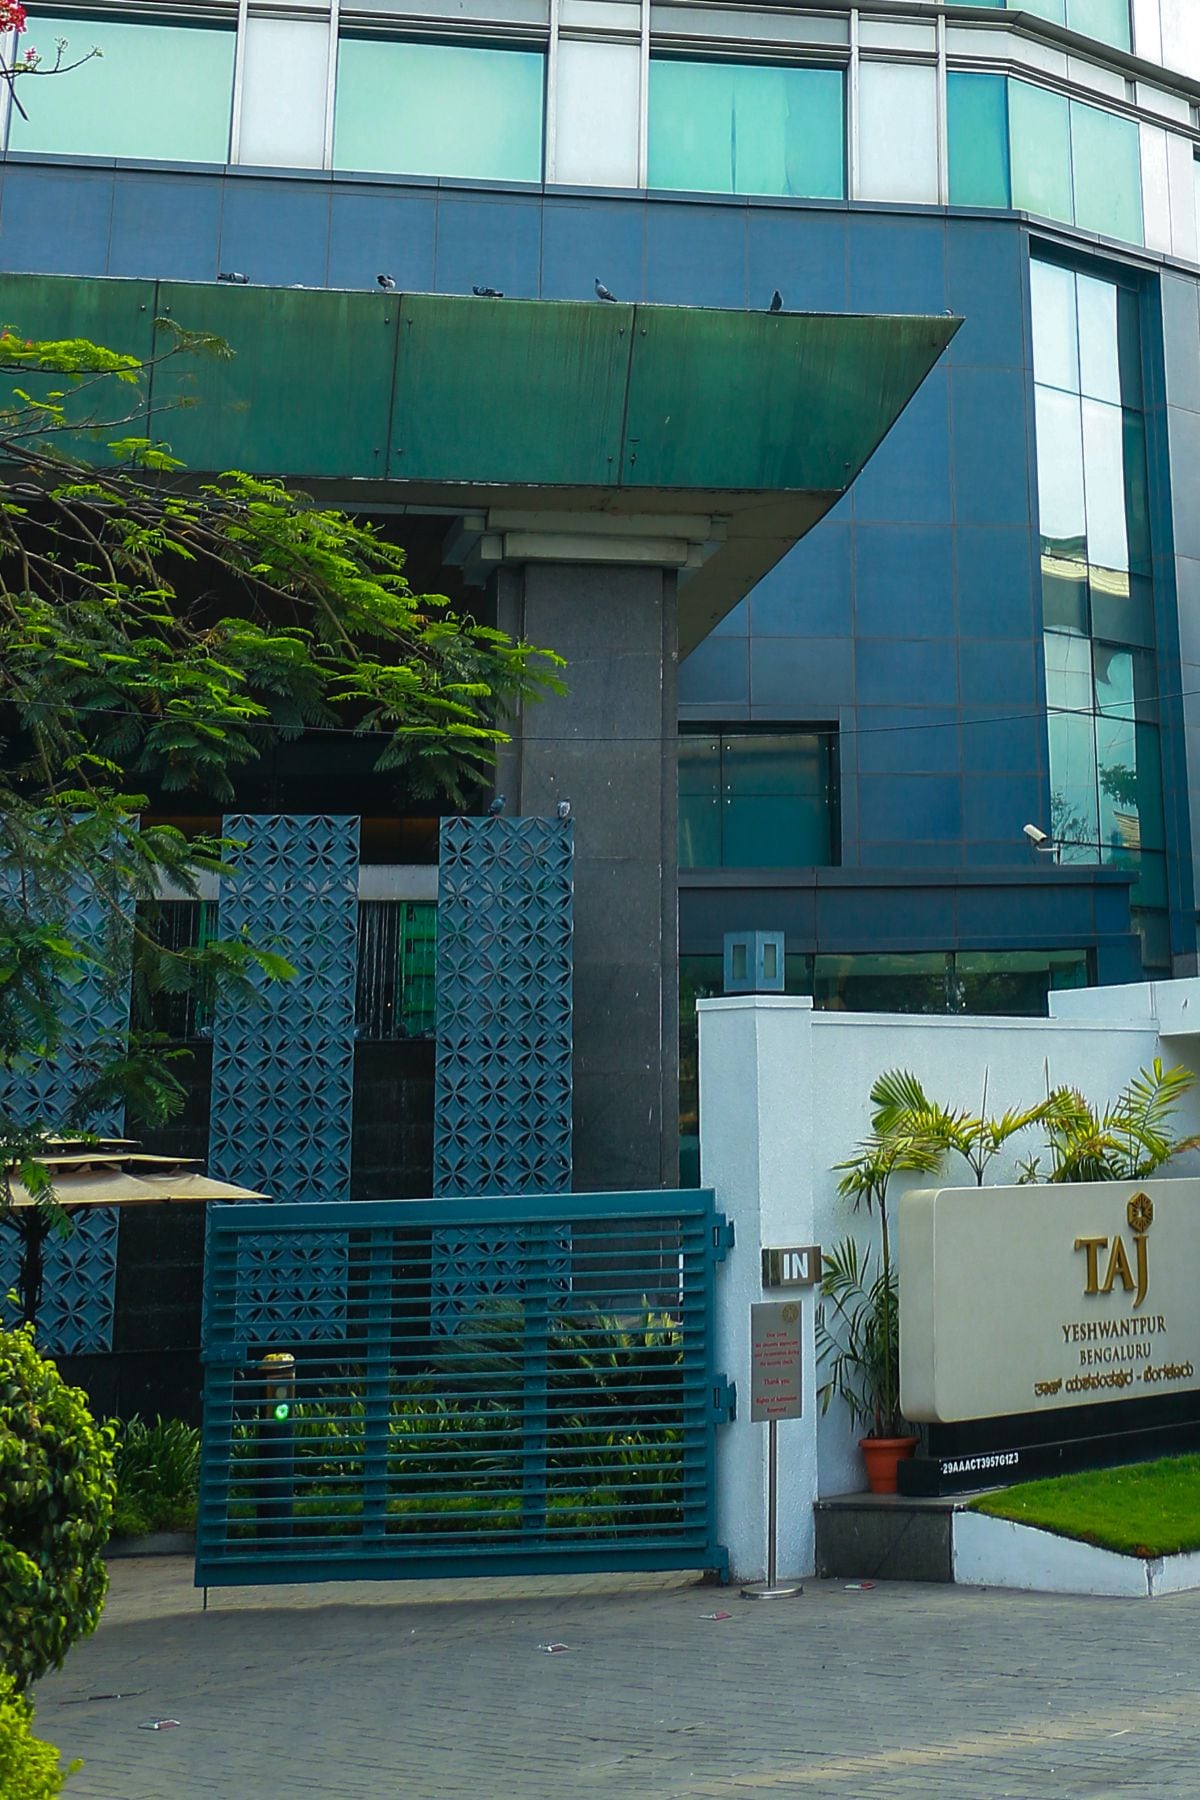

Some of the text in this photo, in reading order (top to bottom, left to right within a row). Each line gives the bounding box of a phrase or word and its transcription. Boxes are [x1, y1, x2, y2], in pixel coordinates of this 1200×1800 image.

[783, 1252, 809, 1280] IN
[1074, 1234, 1149, 1309] TAJ
[1062, 1315, 1167, 1343] YESHWANTPUR
[1079, 1342, 1152, 1366] BENGALURU
